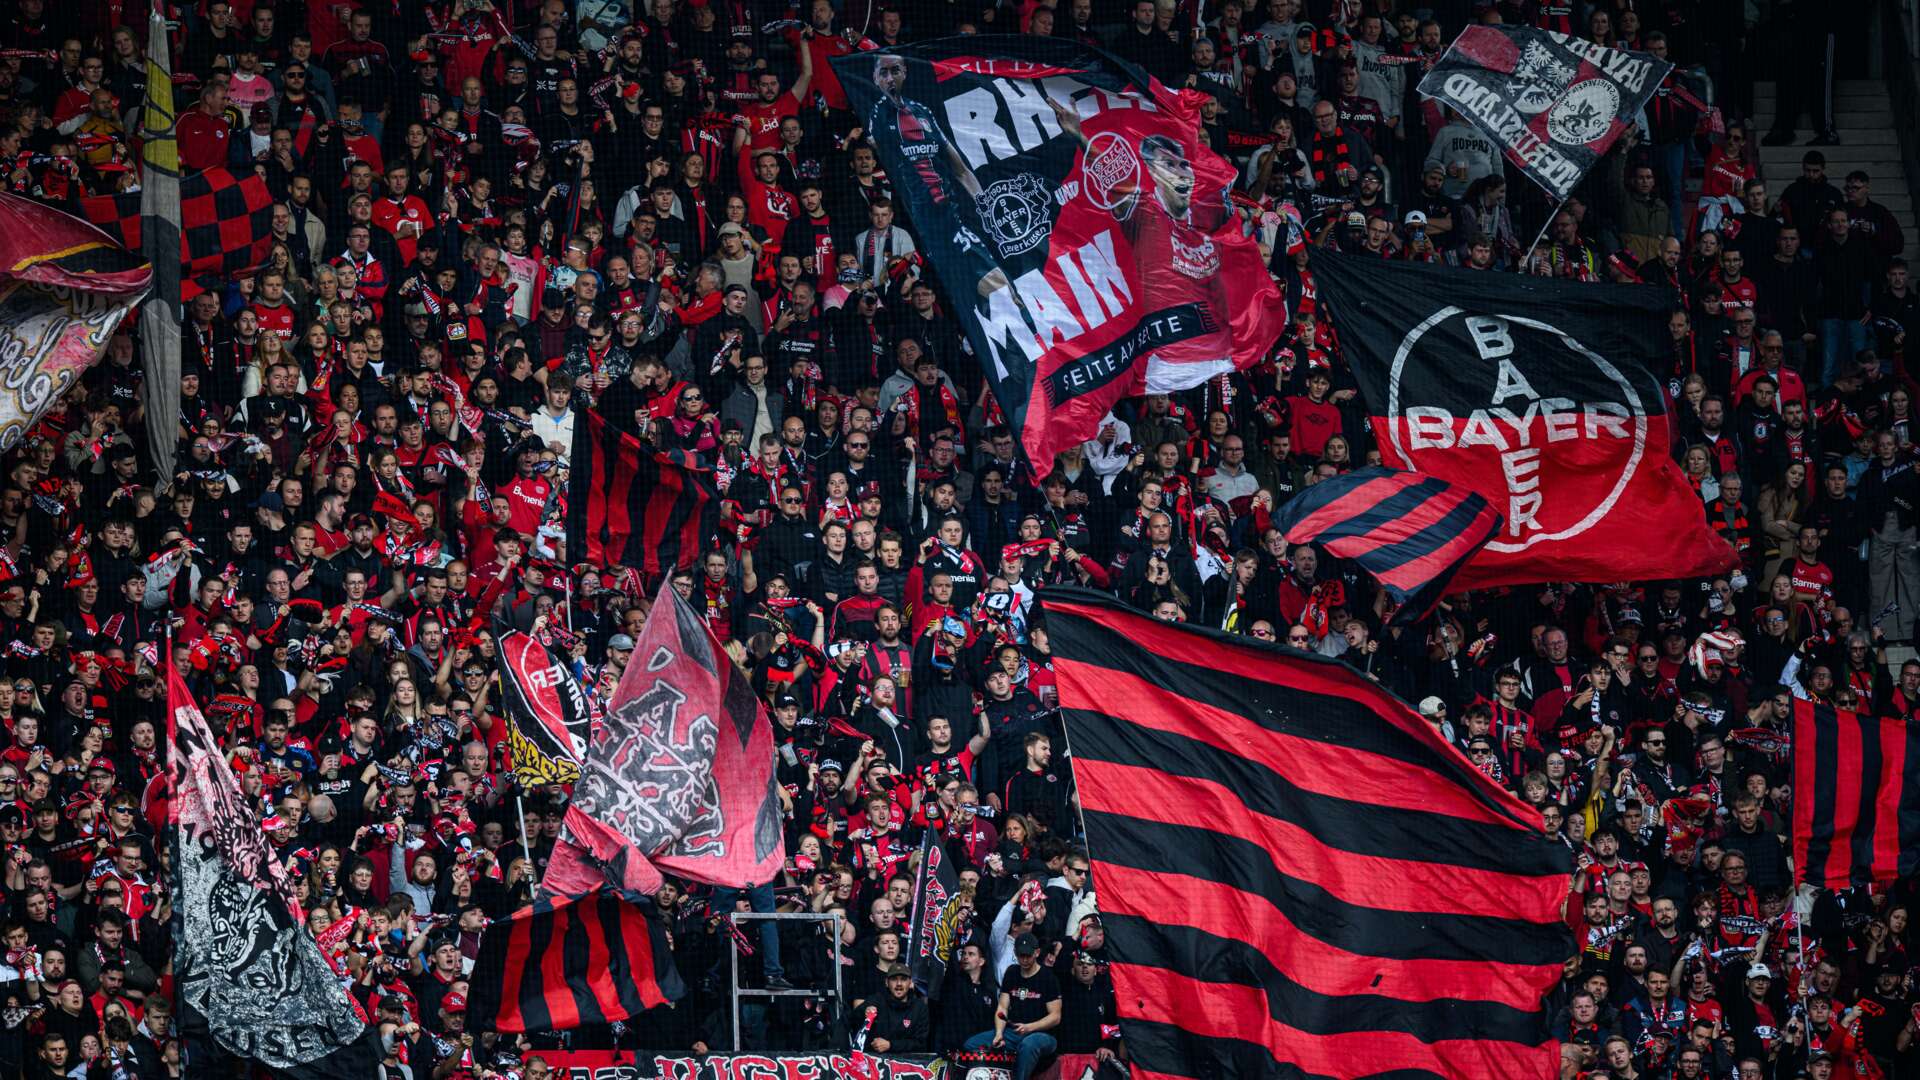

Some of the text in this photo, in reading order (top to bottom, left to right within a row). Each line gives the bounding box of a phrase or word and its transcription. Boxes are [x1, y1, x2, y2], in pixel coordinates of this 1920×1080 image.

[974, 229, 1134, 383] MAIN
[1063, 353, 1116, 391] SEITE
[1406, 397, 1631, 451] BAYER
[1465, 316, 1542, 537] BAYER
[1791, 577, 1822, 590] Barme
